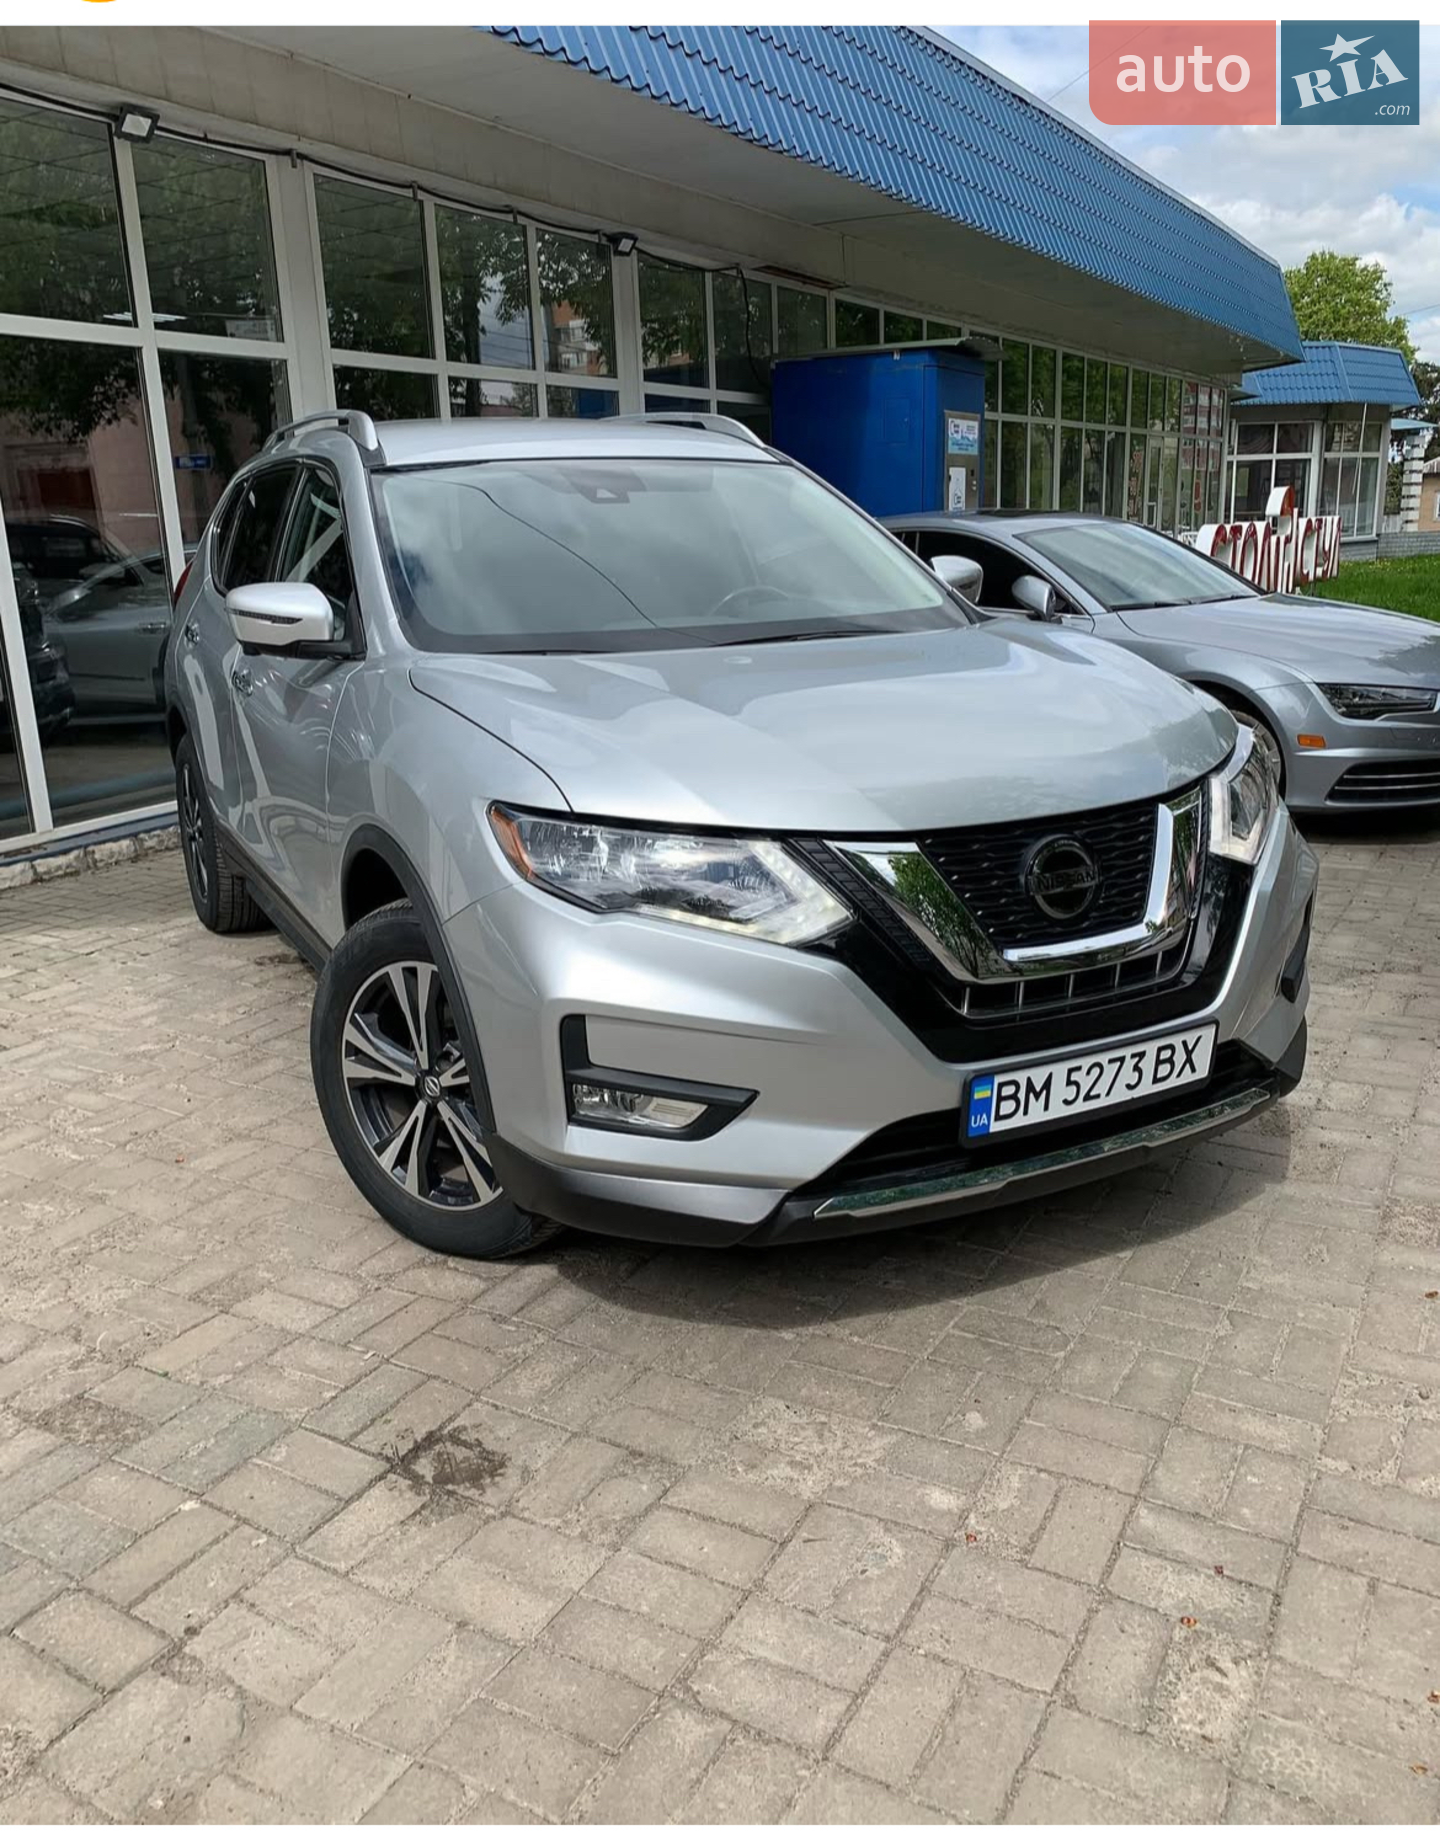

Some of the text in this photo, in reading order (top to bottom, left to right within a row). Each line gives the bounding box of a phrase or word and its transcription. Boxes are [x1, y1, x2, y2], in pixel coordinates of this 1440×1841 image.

[993, 1034, 1203, 1123] BM 5273 BX
[970, 1112, 989, 1129] UA
